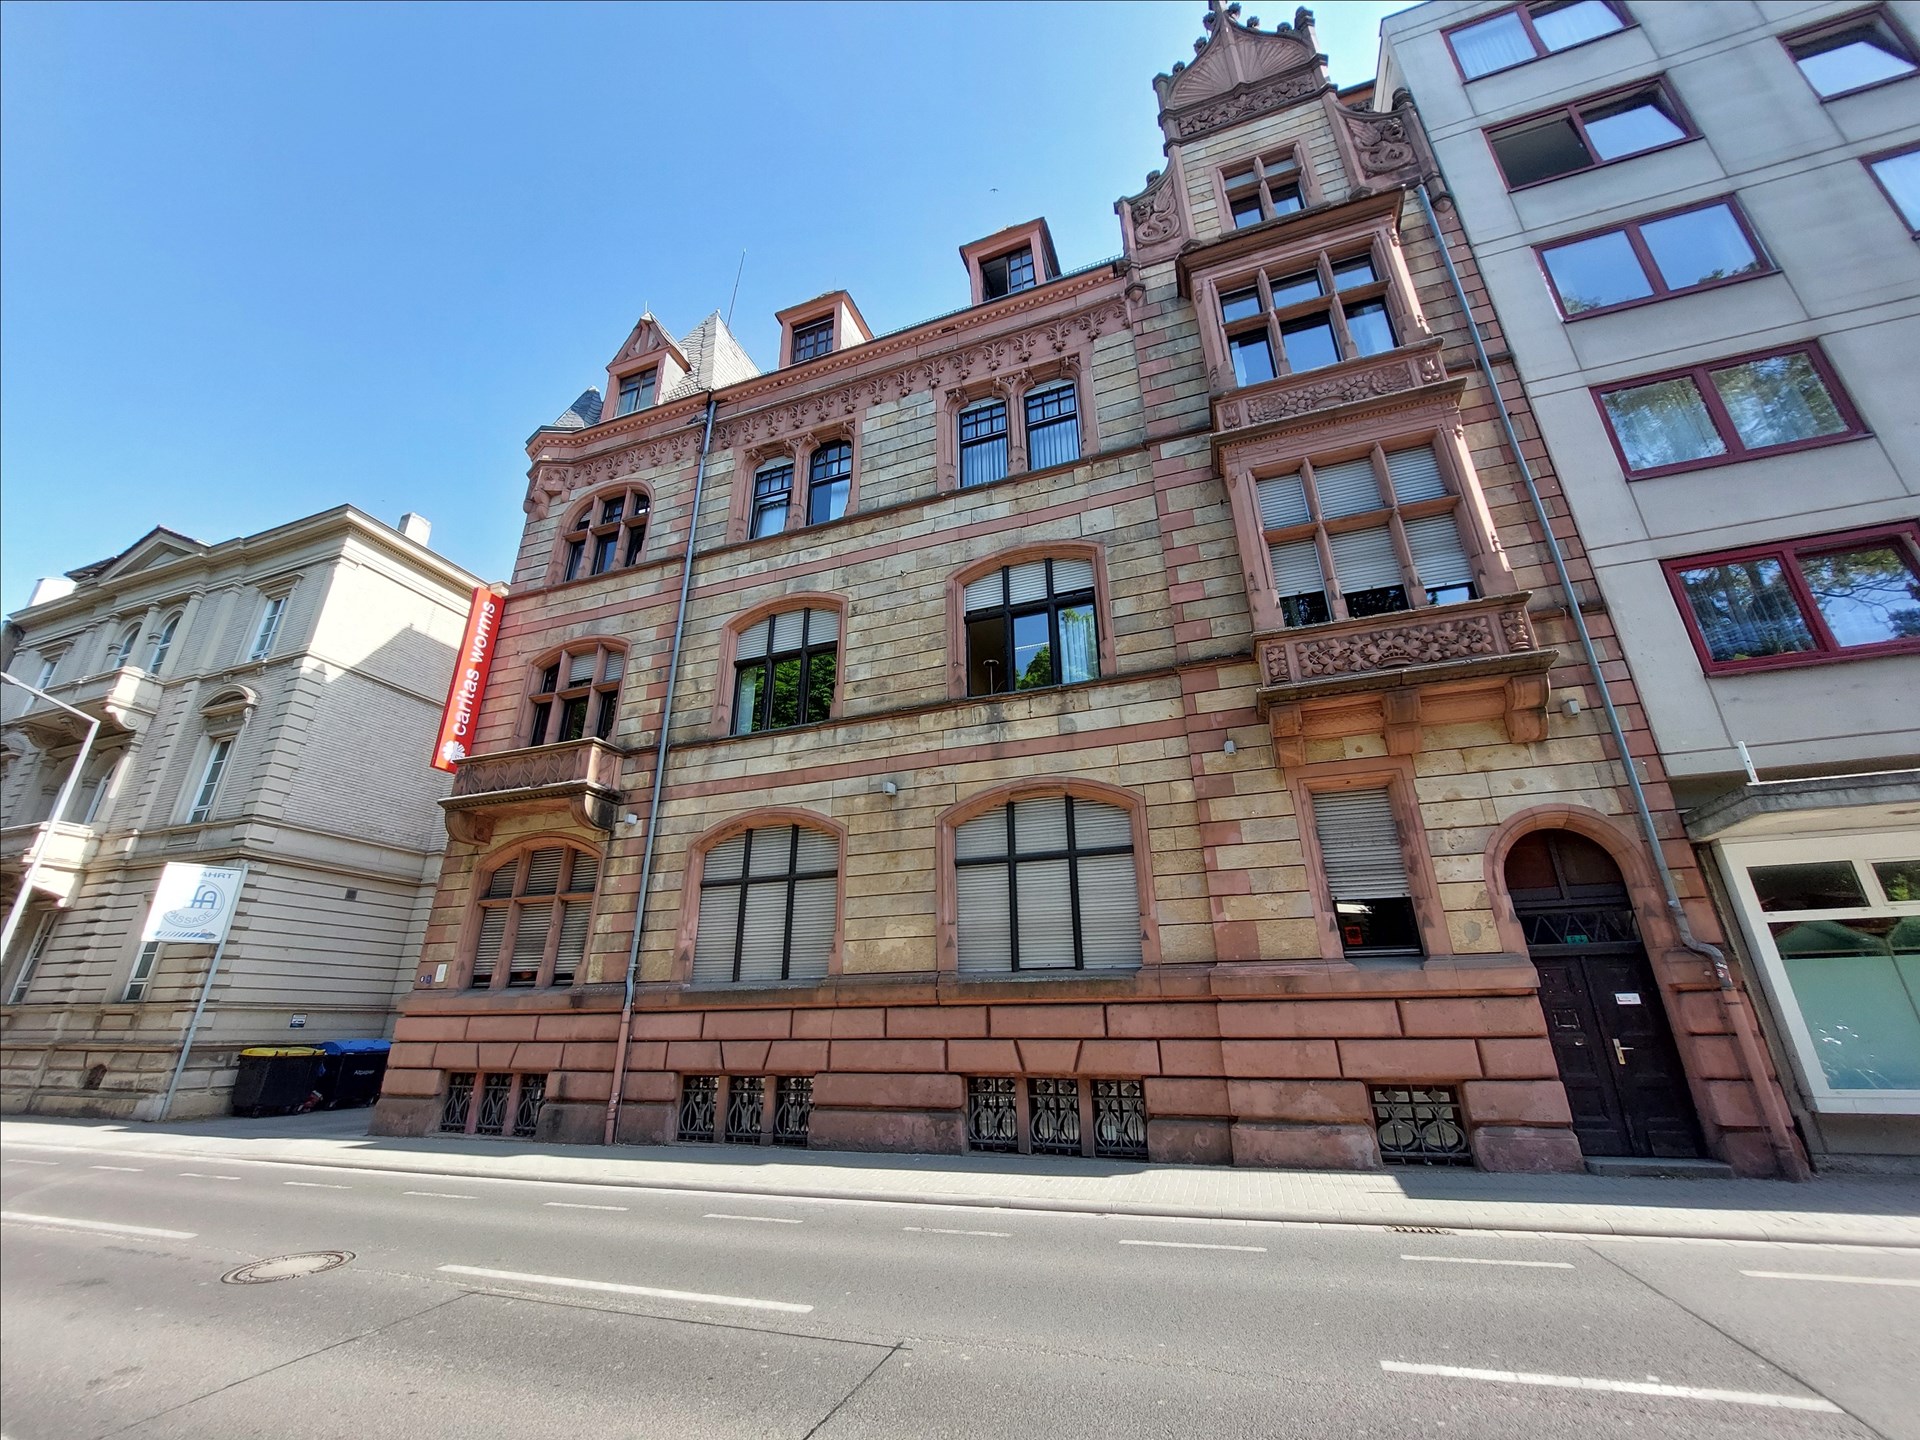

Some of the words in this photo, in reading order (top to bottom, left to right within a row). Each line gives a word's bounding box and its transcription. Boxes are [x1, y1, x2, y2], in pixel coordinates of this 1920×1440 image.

[453, 669, 480, 736] caritas
[470, 601, 496, 663] worms
[200, 871, 235, 879] AHRT
[169, 910, 212, 925] PASSAGE
